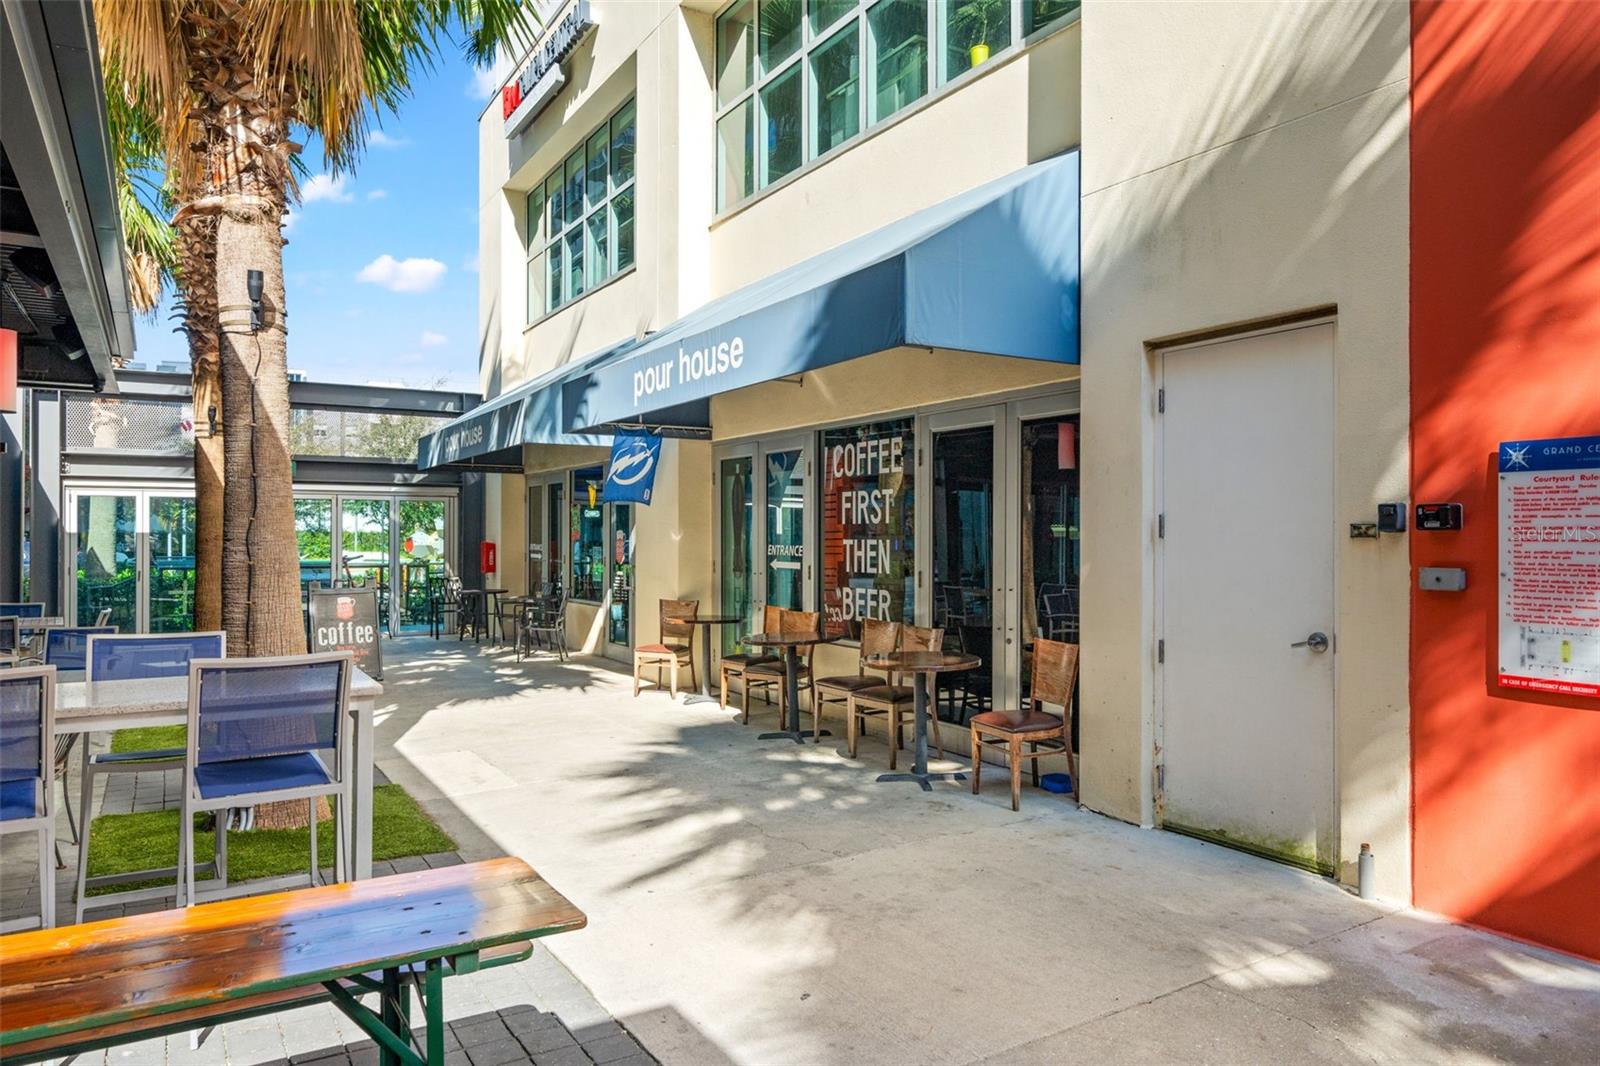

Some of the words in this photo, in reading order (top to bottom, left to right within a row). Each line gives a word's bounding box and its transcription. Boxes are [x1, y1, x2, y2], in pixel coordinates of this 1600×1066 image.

[634, 360, 674, 407] pour
[679, 337, 744, 384] house
[833, 437, 904, 479] COFFEE
[1543, 445, 1582, 456] GRAND
[1533, 474, 1575, 484] Courtyard
[841, 489, 894, 525] FIRST
[768, 544, 804, 557] ENTRANCE
[843, 539, 891, 575] THEN
[842, 586, 892, 622] BEER
[318, 621, 374, 646] coffee
